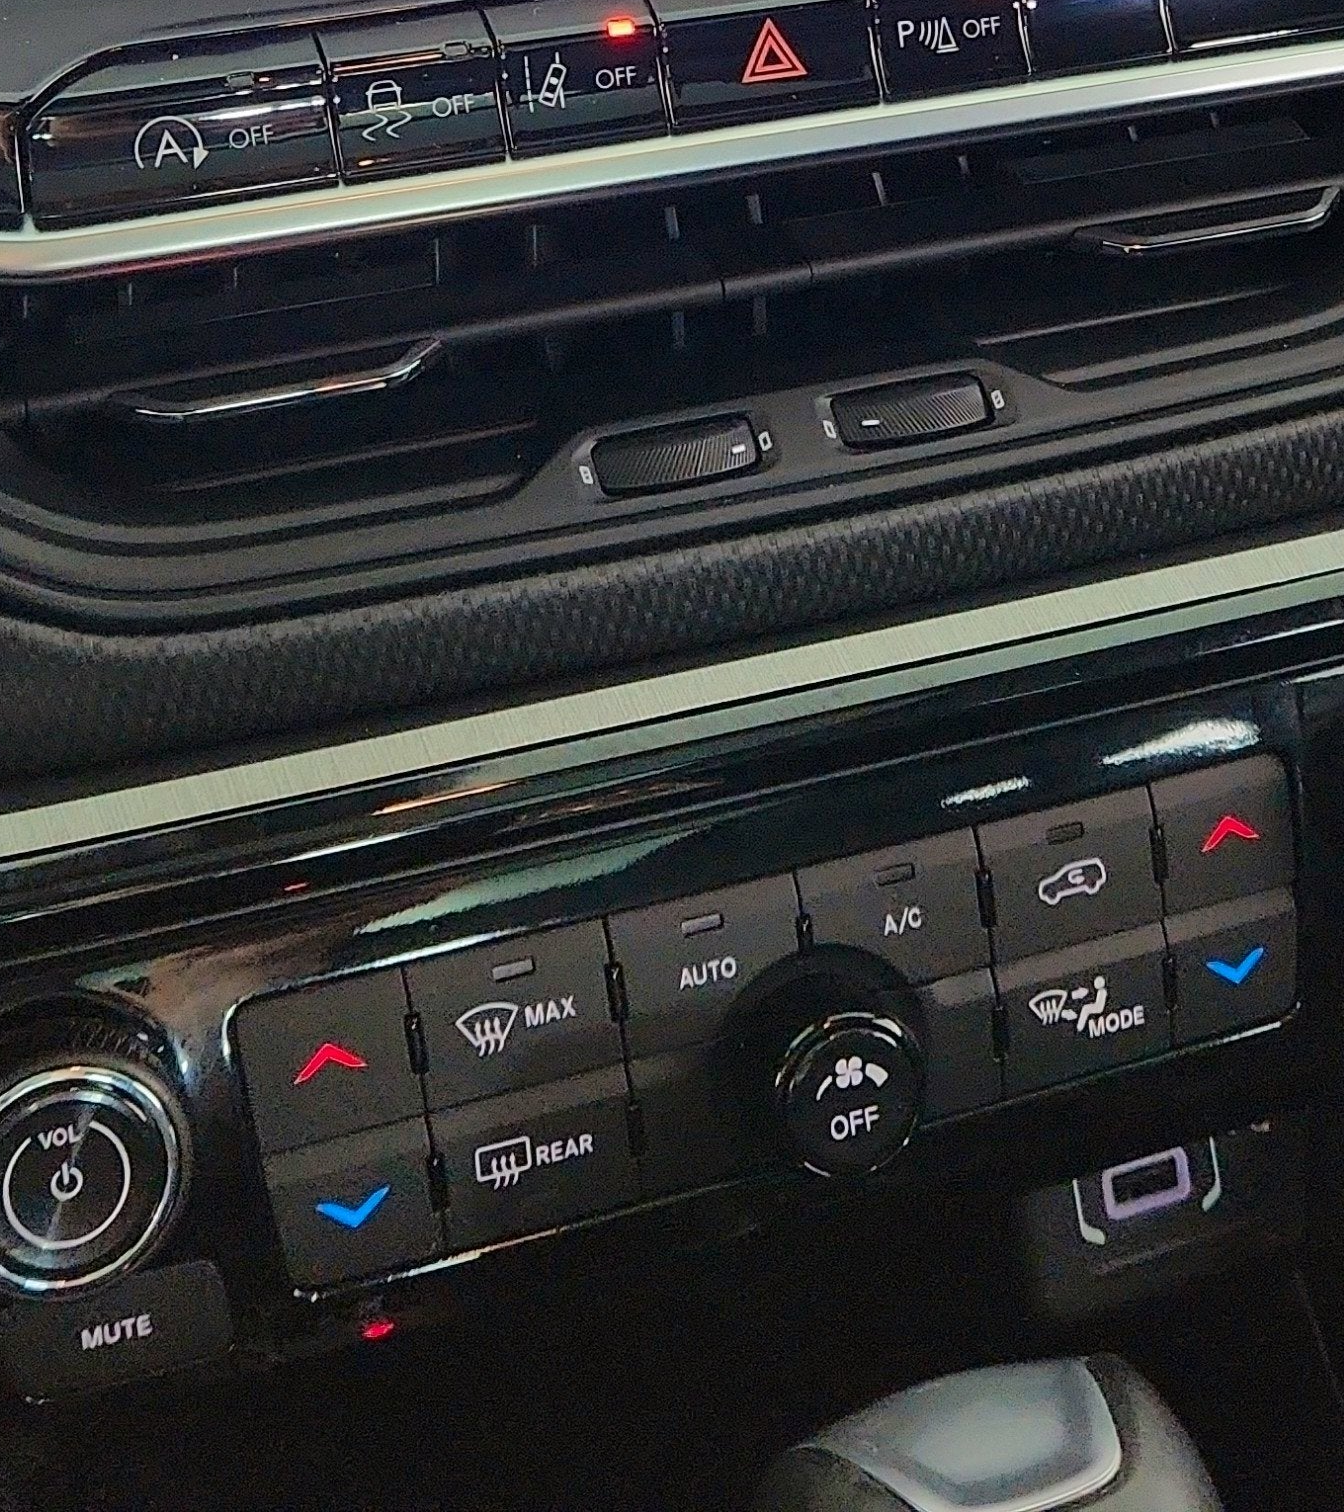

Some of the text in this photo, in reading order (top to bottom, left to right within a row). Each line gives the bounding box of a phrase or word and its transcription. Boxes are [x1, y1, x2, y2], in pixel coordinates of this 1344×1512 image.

[962, 16, 1001, 40] OFF
[595, 66, 637, 89] OFF
[432, 95, 476, 118] OFF
[228, 124, 274, 149] OFF
[883, 906, 923, 936] A/C
[679, 956, 737, 990] AUTO
[524, 996, 576, 1028] MAX
[1088, 1005, 1145, 1038] MODE
[38, 1123, 80, 1151] VOL
[830, 1105, 881, 1141] OFF
[536, 1133, 593, 1166] REAR
[81, 1313, 154, 1351] MUTE
